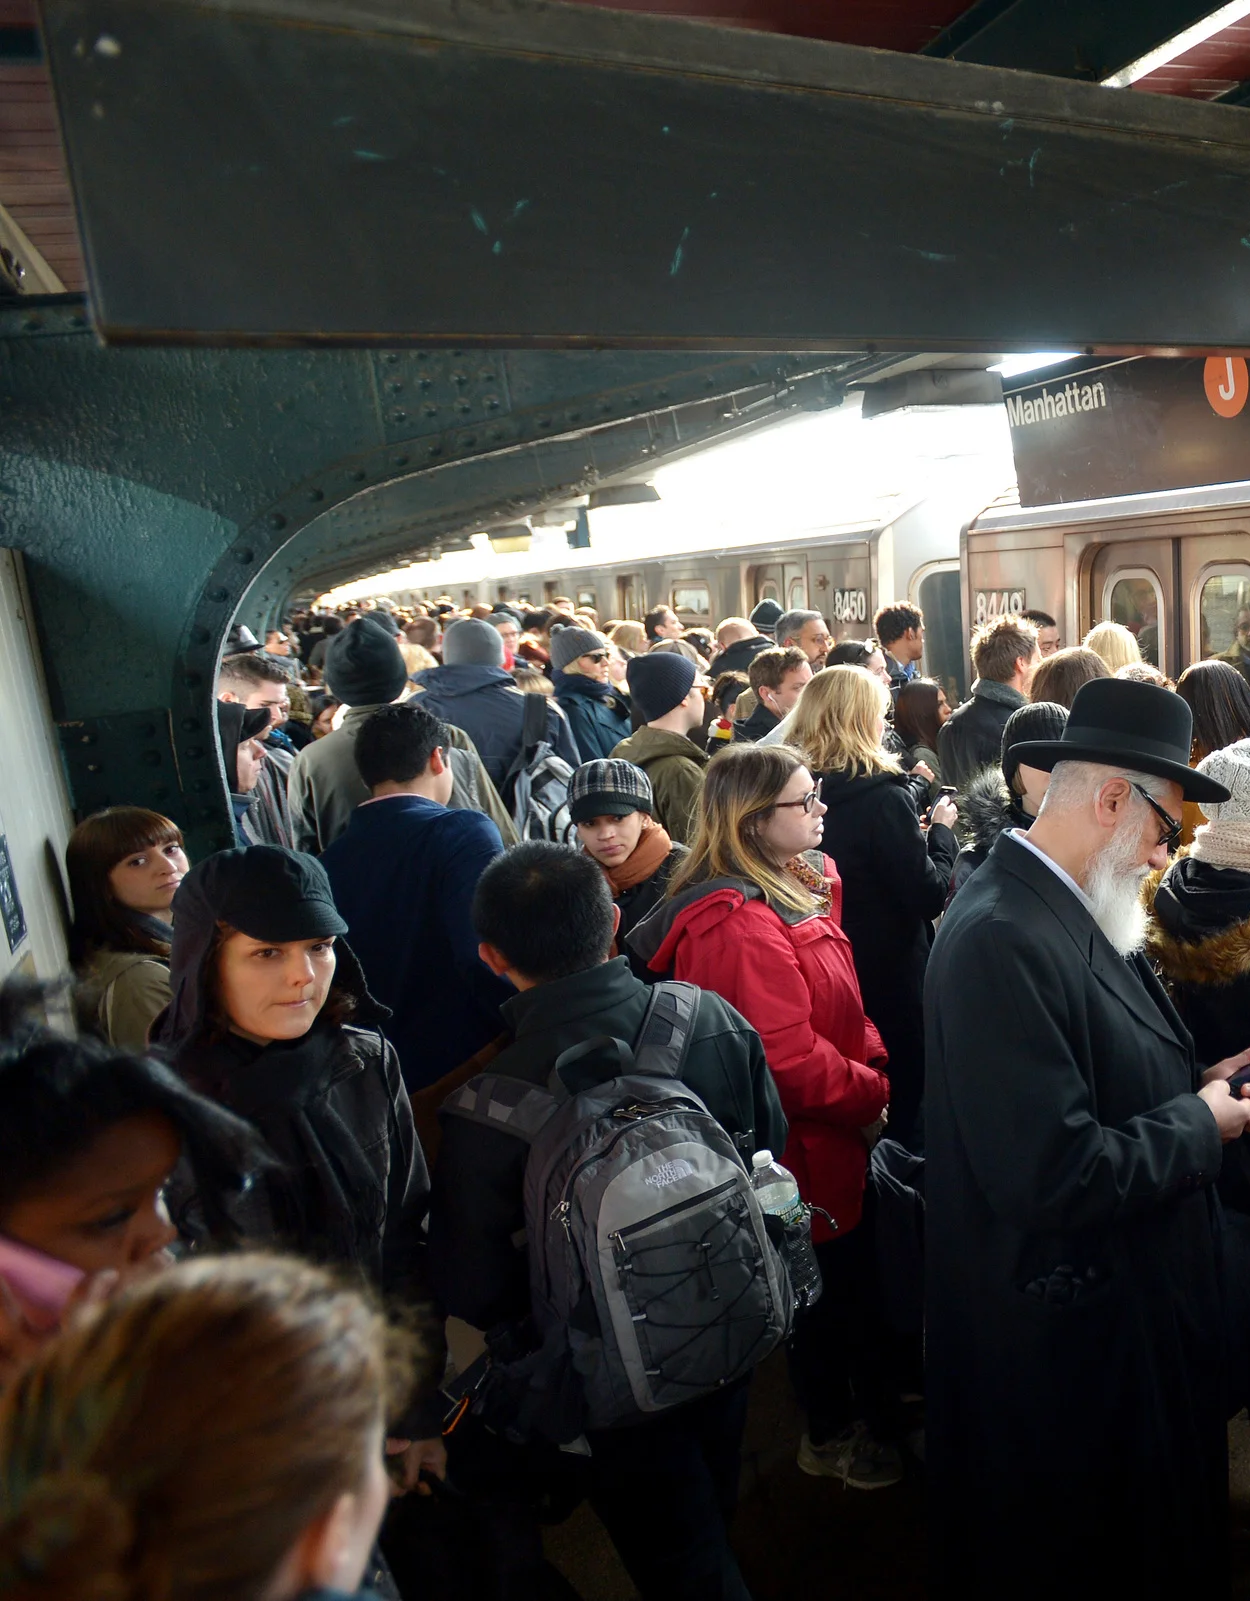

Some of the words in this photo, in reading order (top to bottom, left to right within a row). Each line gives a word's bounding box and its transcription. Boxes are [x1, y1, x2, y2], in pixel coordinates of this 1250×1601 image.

[1006, 381, 1107, 428] Manhattan
[835, 591, 866, 621] 8450
[656, 1161, 675, 1173] THE
[645, 1169, 677, 1185] NORTH
[656, 1175, 679, 1189] FACE
